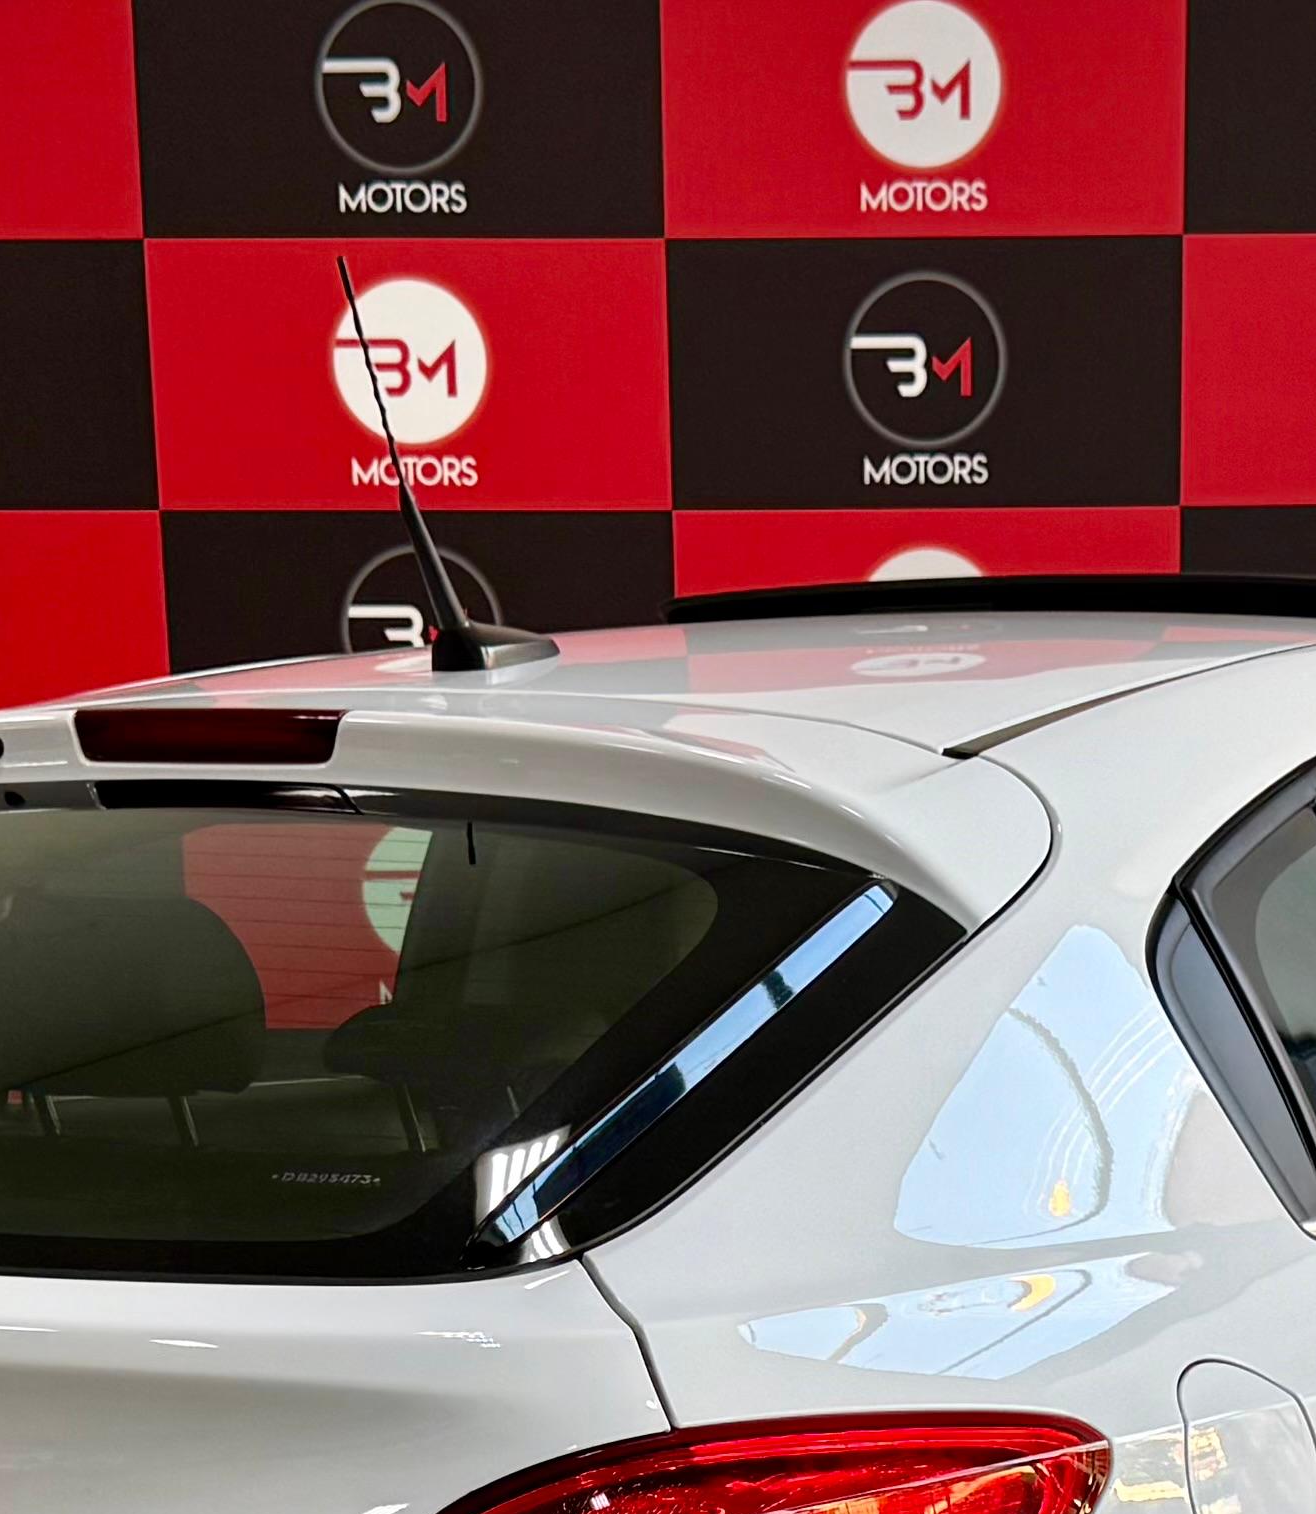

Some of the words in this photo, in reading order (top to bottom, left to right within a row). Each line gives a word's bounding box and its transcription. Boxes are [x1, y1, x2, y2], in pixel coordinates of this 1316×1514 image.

[323, 57, 447, 123] BM
[849, 59, 971, 120] BM
[339, 182, 467, 213] MOTORS
[861, 180, 987, 211] MOTORS
[335, 337, 457, 398] BM
[851, 335, 972, 397] BM
[351, 455, 479, 487] MOTORS
[864, 454, 988, 484] MOTORS
